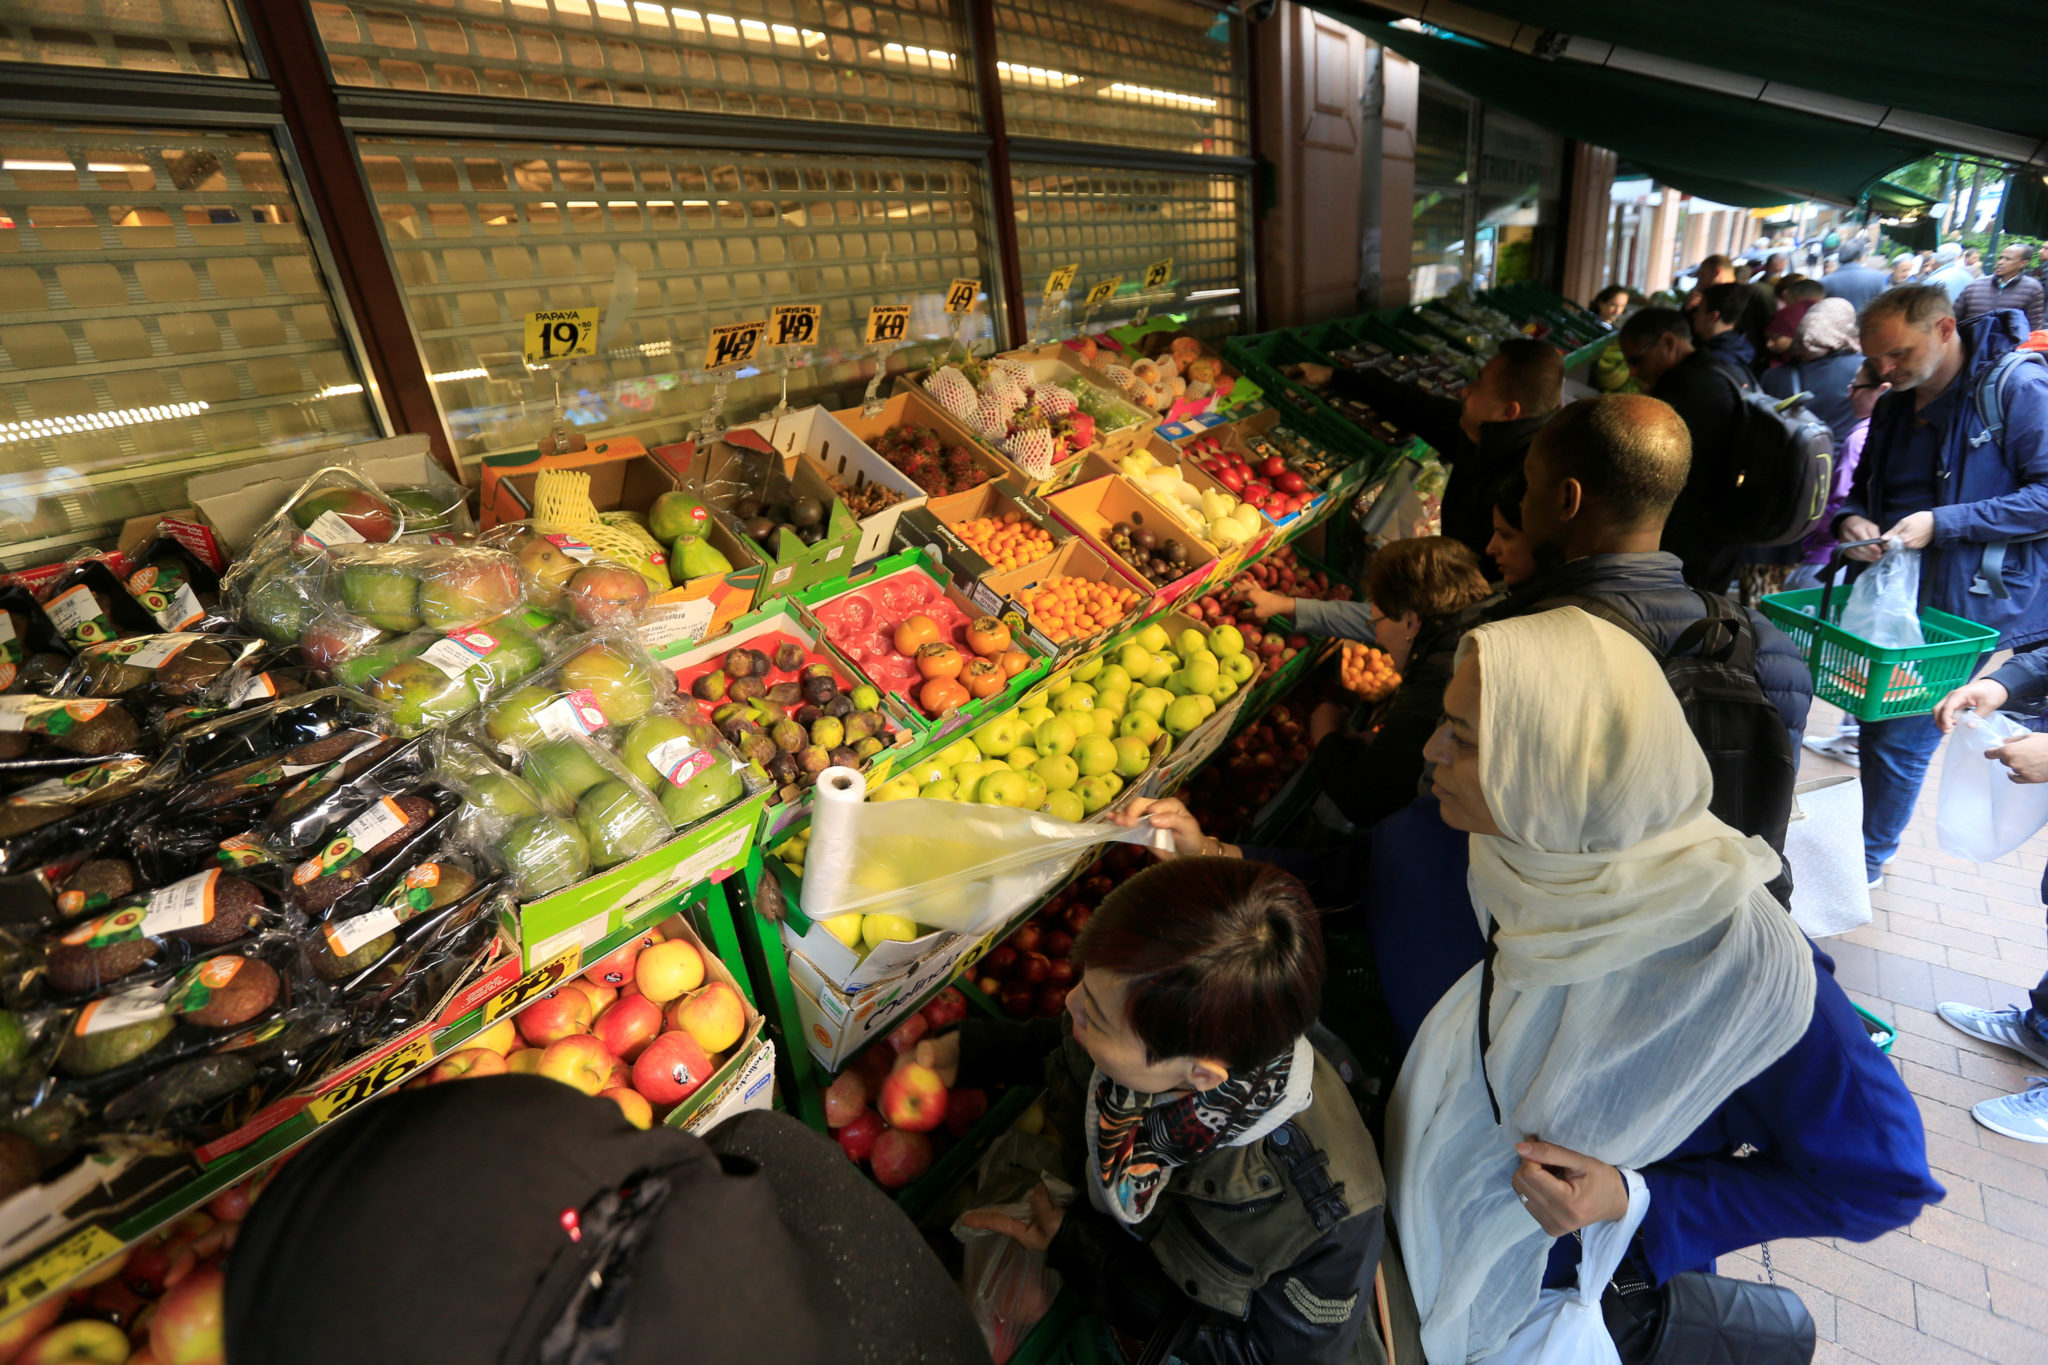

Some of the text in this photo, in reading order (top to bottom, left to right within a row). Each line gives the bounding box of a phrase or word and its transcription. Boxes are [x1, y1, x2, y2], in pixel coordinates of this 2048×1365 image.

[535, 310, 580, 321] PAPAYA
[948, 285, 974, 312] 49
[538, 321, 579, 360] 19
[775, 313, 814, 345] 149
[863, 950, 964, 1031] Melinda
[327, 1059, 418, 1120] 26
